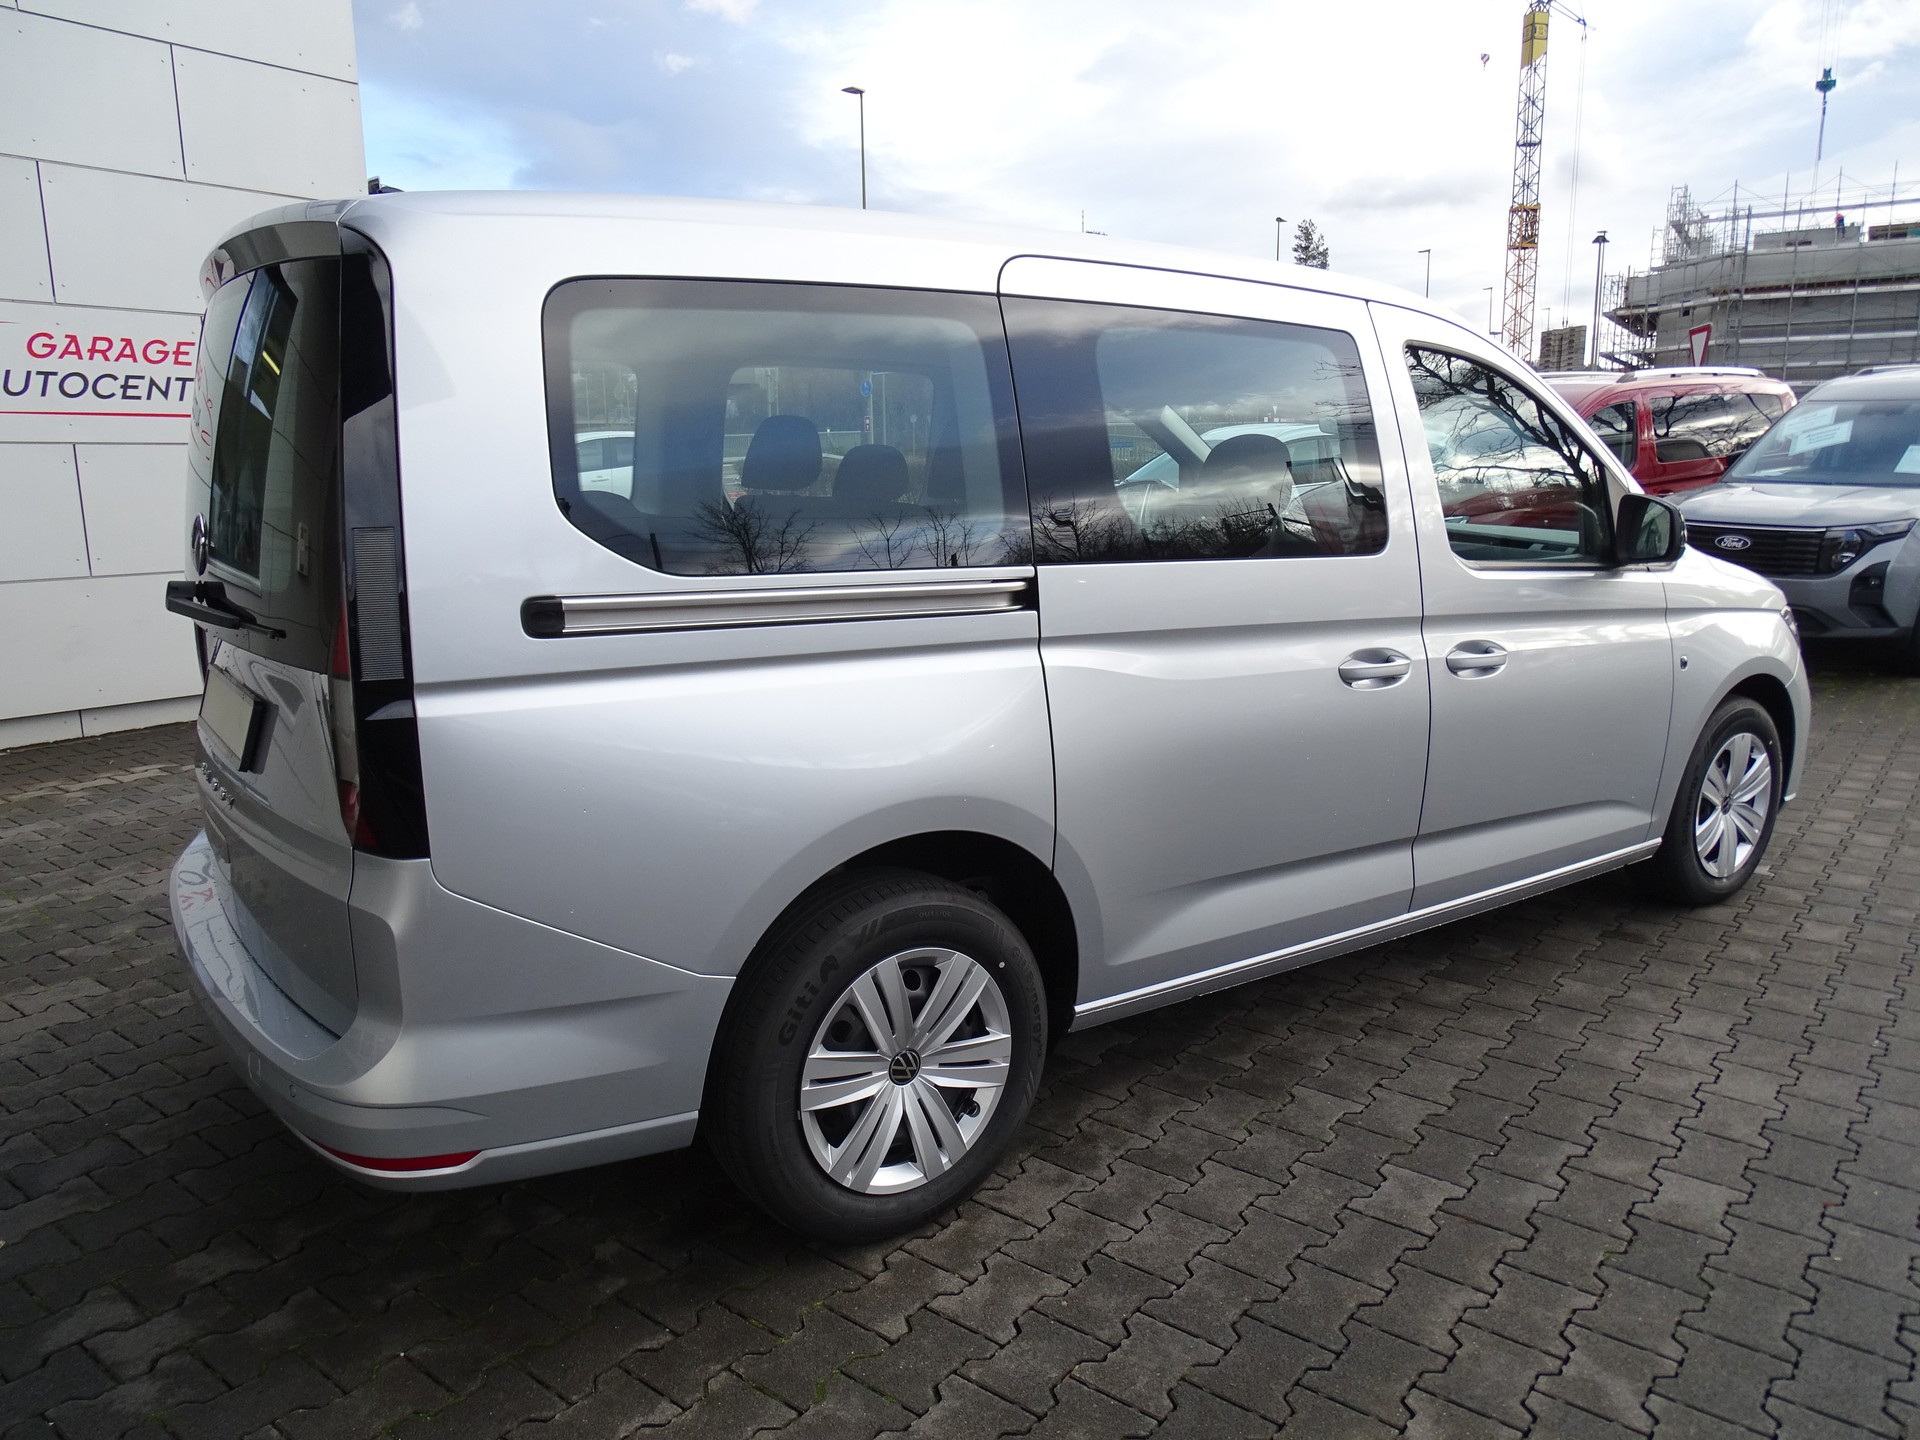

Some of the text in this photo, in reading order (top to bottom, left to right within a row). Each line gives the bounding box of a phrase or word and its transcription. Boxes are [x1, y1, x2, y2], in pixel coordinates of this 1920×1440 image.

[26, 332, 196, 367] GARAGE
[2, 369, 195, 402] UTOCENT
[1720, 537, 1744, 548] Ford
[778, 981, 820, 1047] Giti
